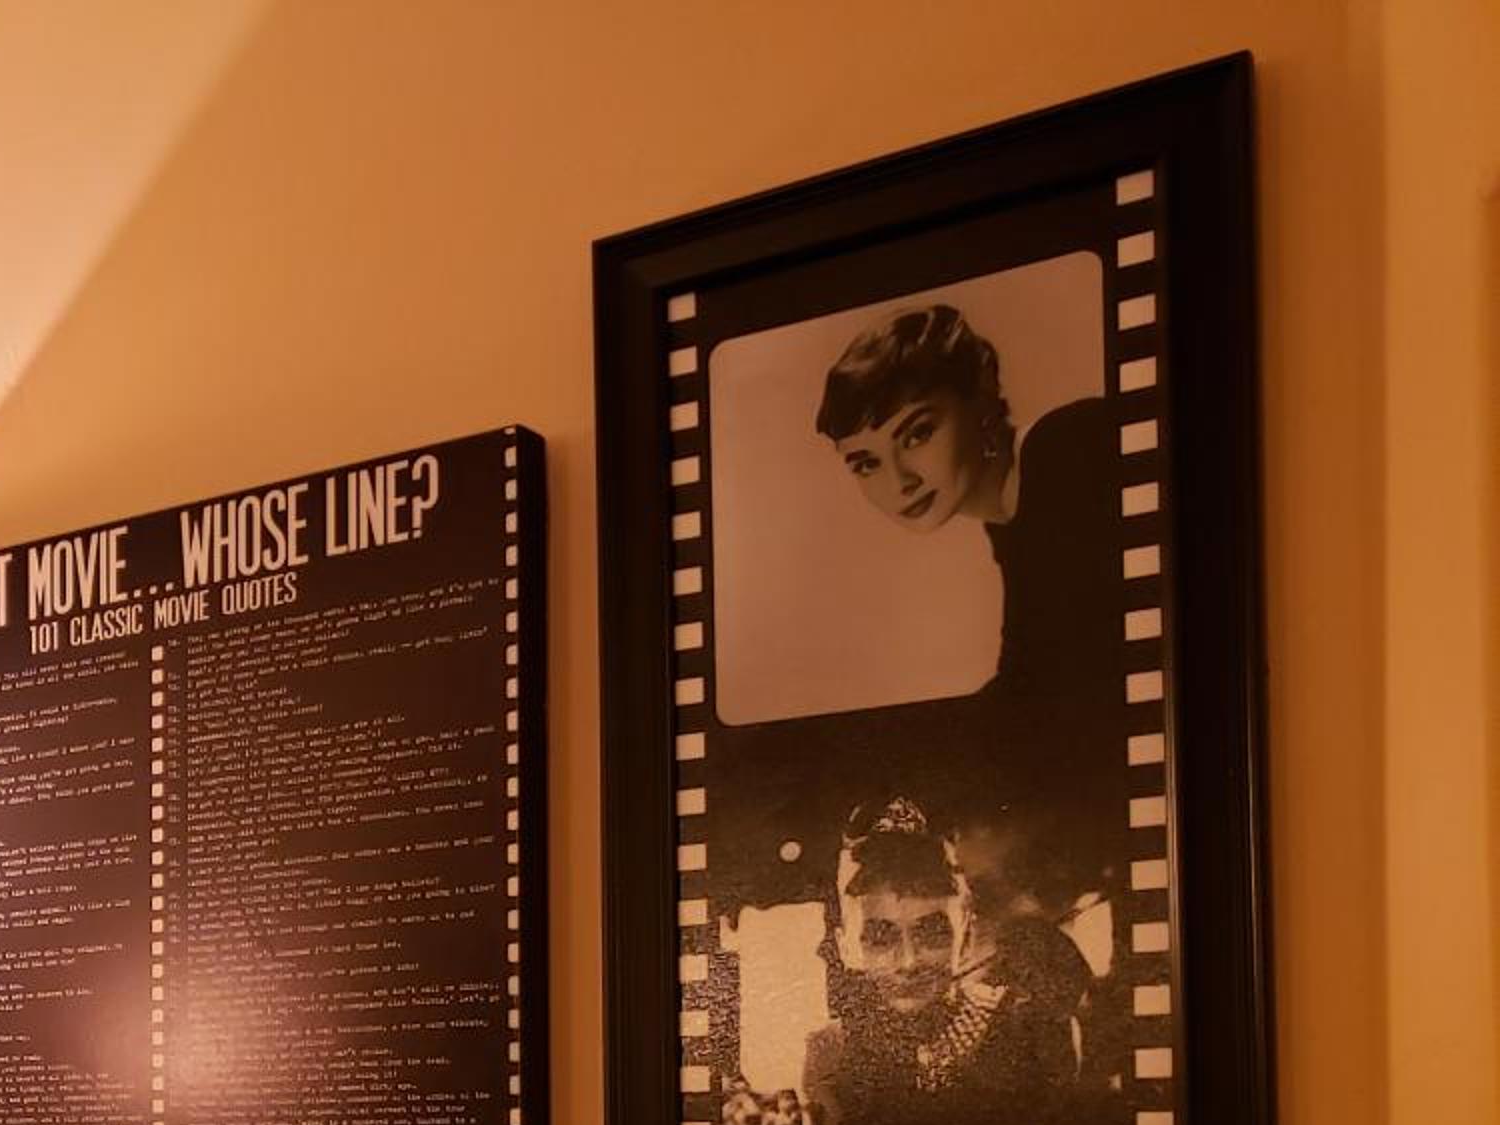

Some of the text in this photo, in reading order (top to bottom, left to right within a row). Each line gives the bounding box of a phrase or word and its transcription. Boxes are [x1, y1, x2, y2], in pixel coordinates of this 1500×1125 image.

[326, 454, 439, 557] LINE?
[30, 571, 298, 655] 101 CLASSIC MOVIE QUOTES
